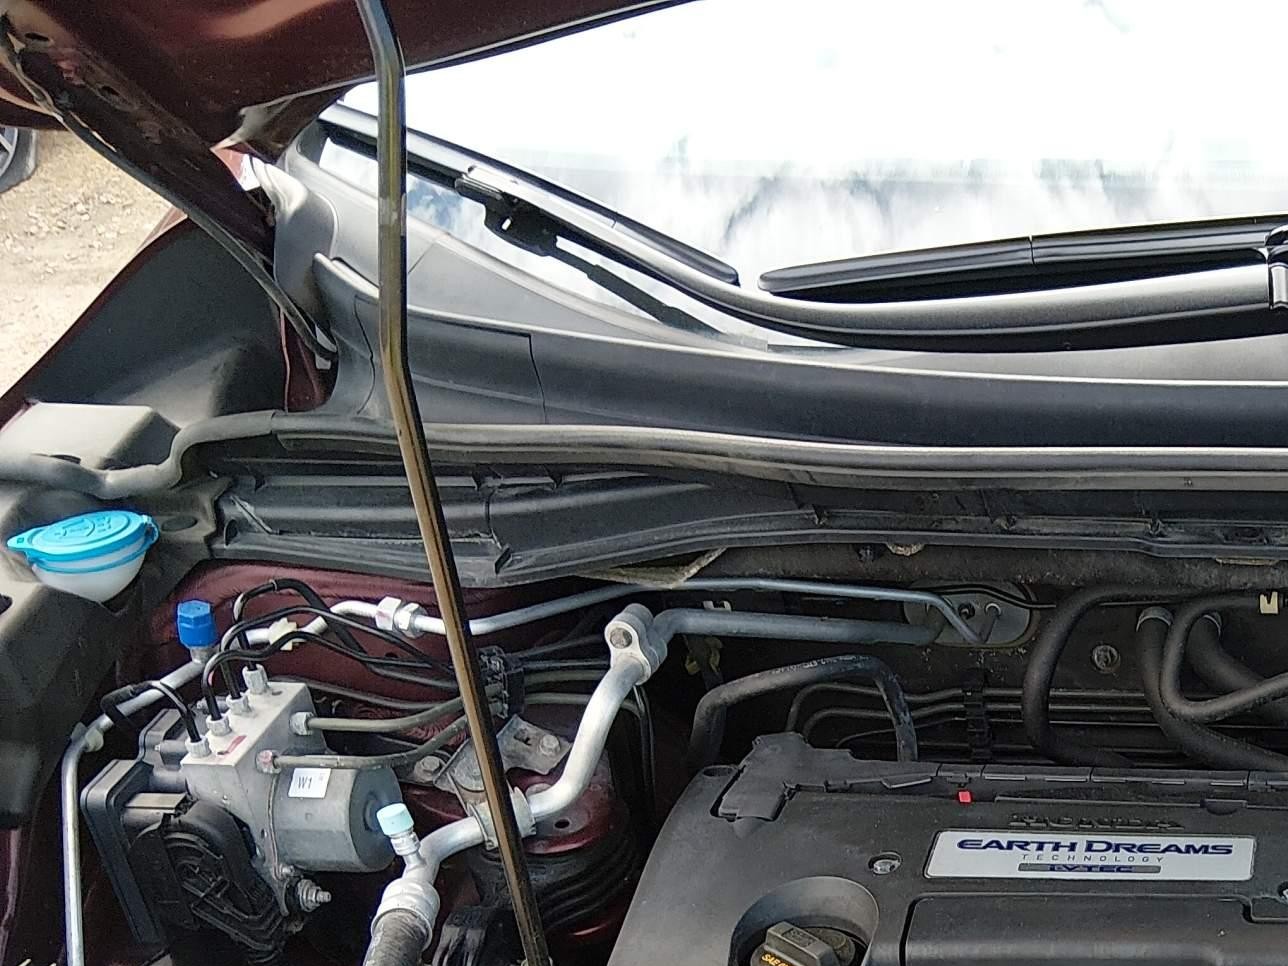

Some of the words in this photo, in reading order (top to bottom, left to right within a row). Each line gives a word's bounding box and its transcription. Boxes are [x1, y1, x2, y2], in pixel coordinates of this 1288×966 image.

[957, 838, 1078, 853] EARTH
[1085, 839, 1233, 855] DREAMS
[1022, 854, 1165, 863] TECHNOLOGY
[761, 953, 780, 966] SAE
